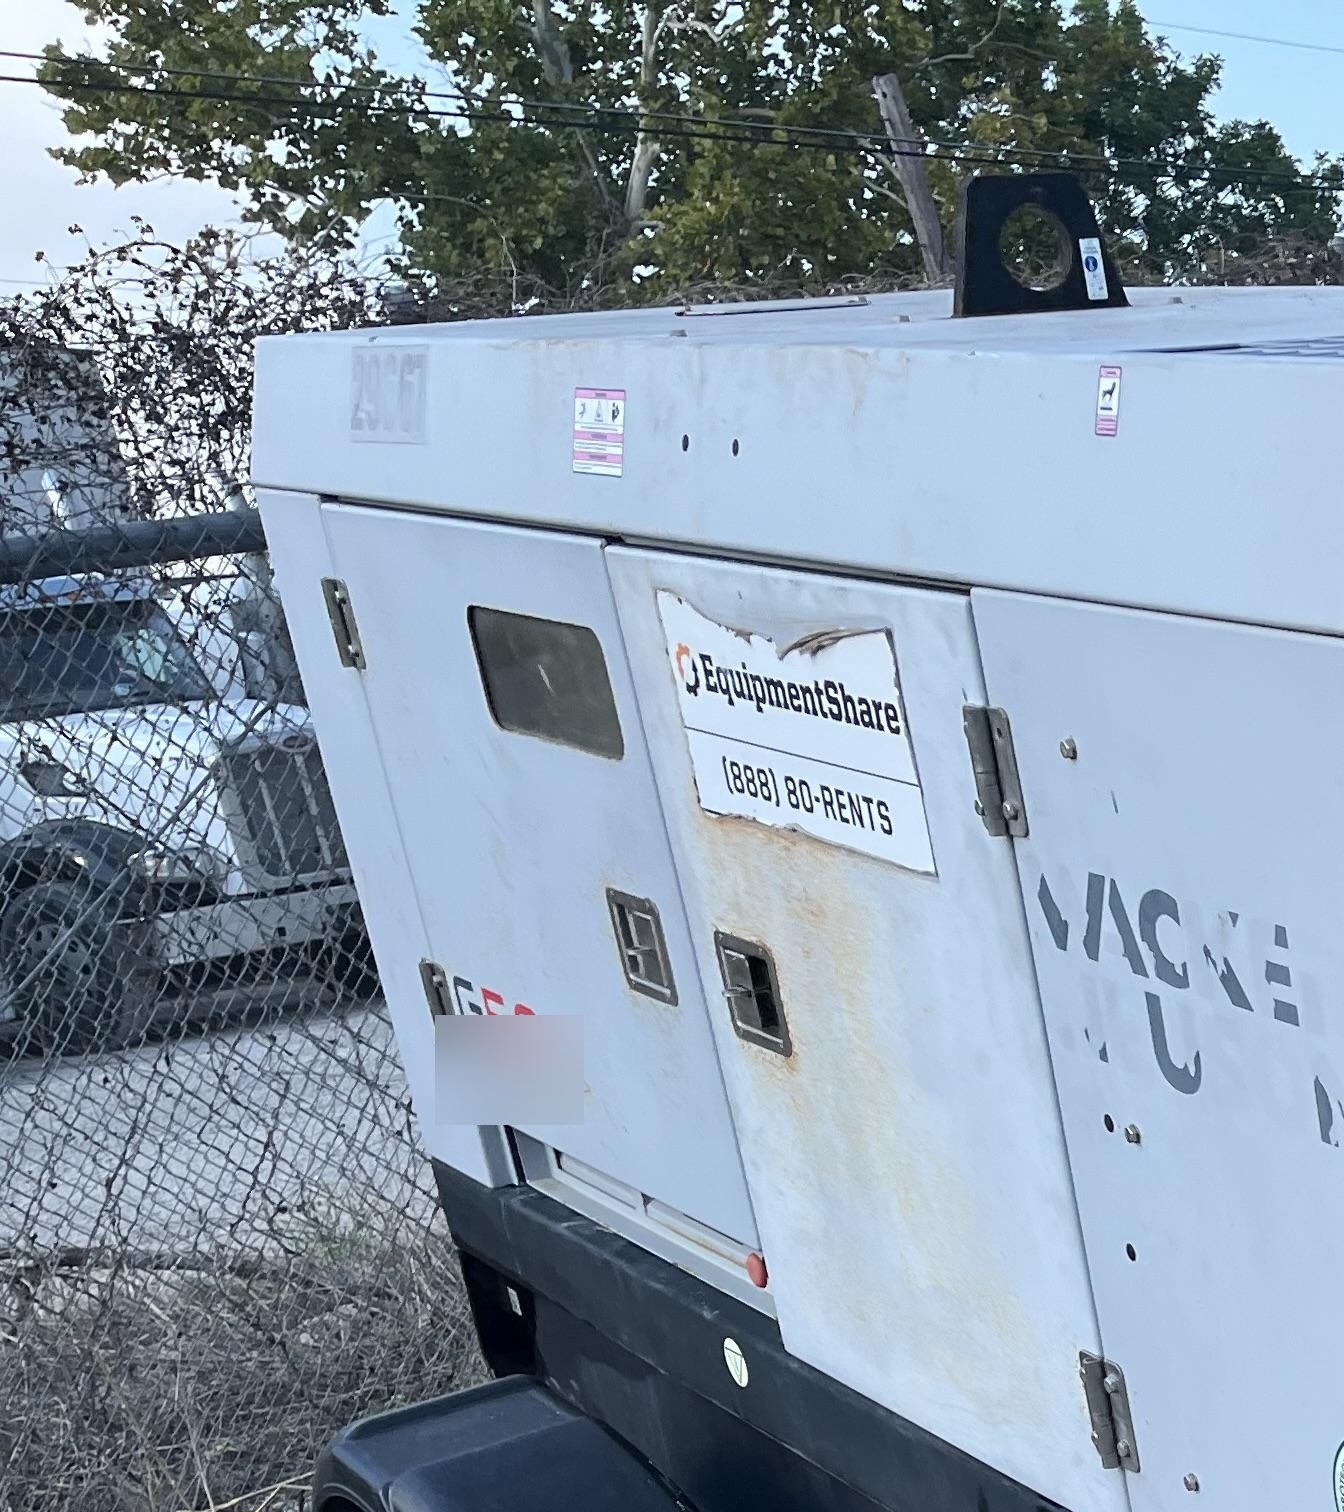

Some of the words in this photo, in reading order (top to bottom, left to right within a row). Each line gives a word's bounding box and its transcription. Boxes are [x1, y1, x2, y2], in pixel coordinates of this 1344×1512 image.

[698, 652, 901, 735] EquipmentShare
[722, 755, 780, 808] (888)
[784, 775, 894, 836] 80-RENTS
